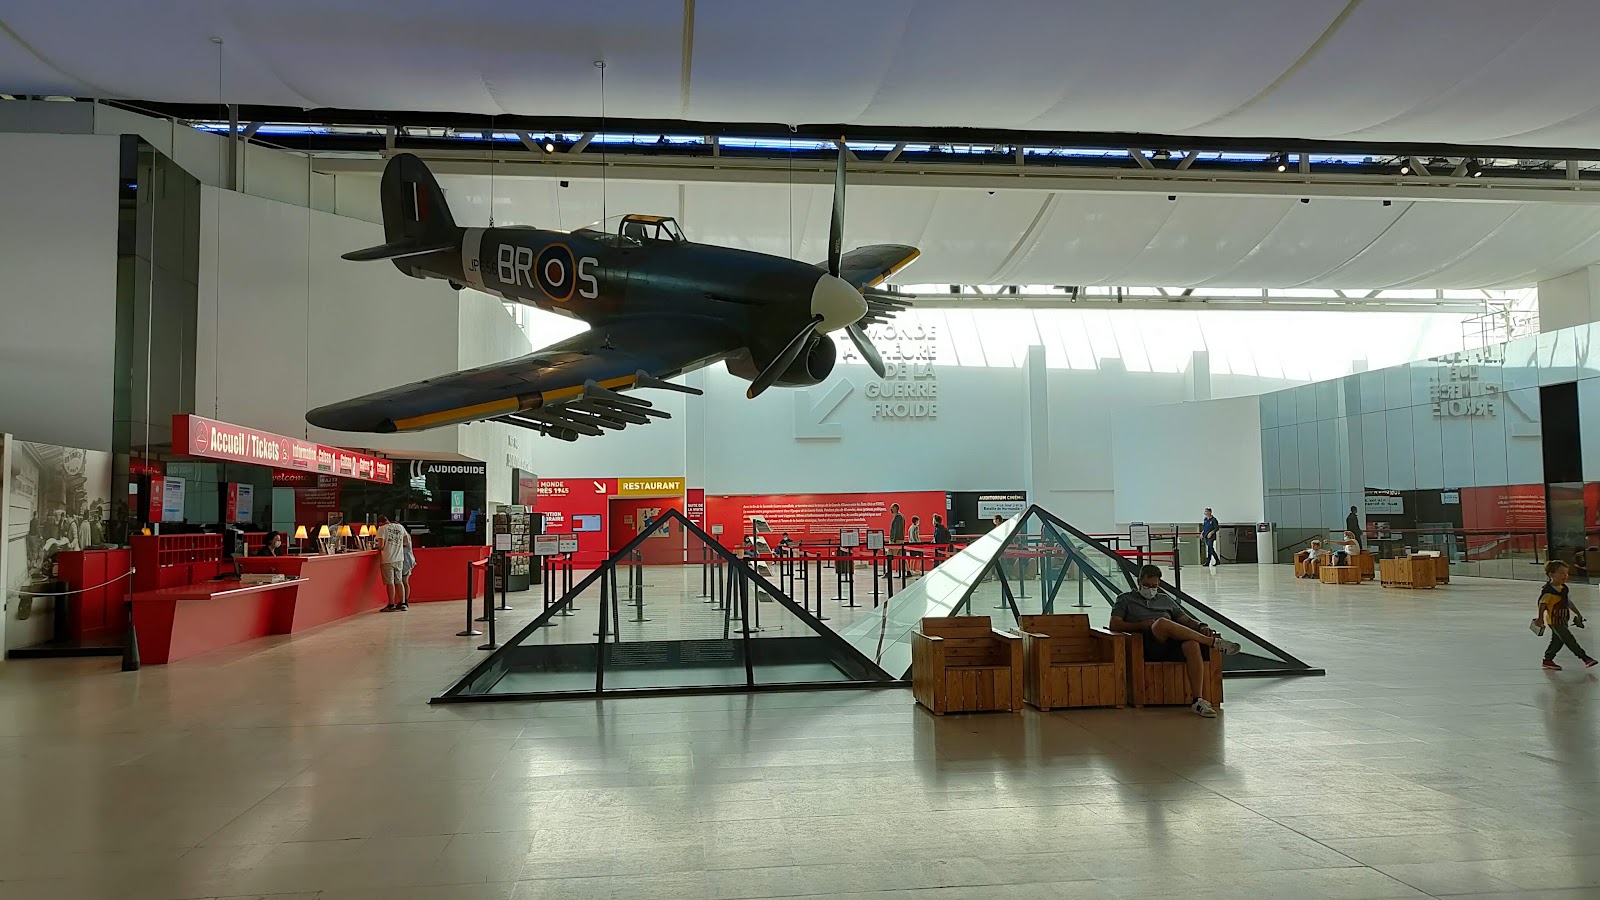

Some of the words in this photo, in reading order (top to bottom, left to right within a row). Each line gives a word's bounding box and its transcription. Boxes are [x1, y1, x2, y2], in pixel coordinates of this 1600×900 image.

[498, 243, 534, 289] BR
[578, 256, 599, 299] S
[885, 363, 906, 380] DE
[914, 363, 936, 381] LA
[865, 381, 937, 400] GUERRE
[872, 402, 937, 420] FROIDE
[210, 426, 245, 456] Accueil
[251, 434, 280, 461] Tickets
[428, 465, 485, 475] AUDIOGUIDE
[536, 486, 553, 494] PRÈS
[622, 481, 681, 490] RESTAURANT
